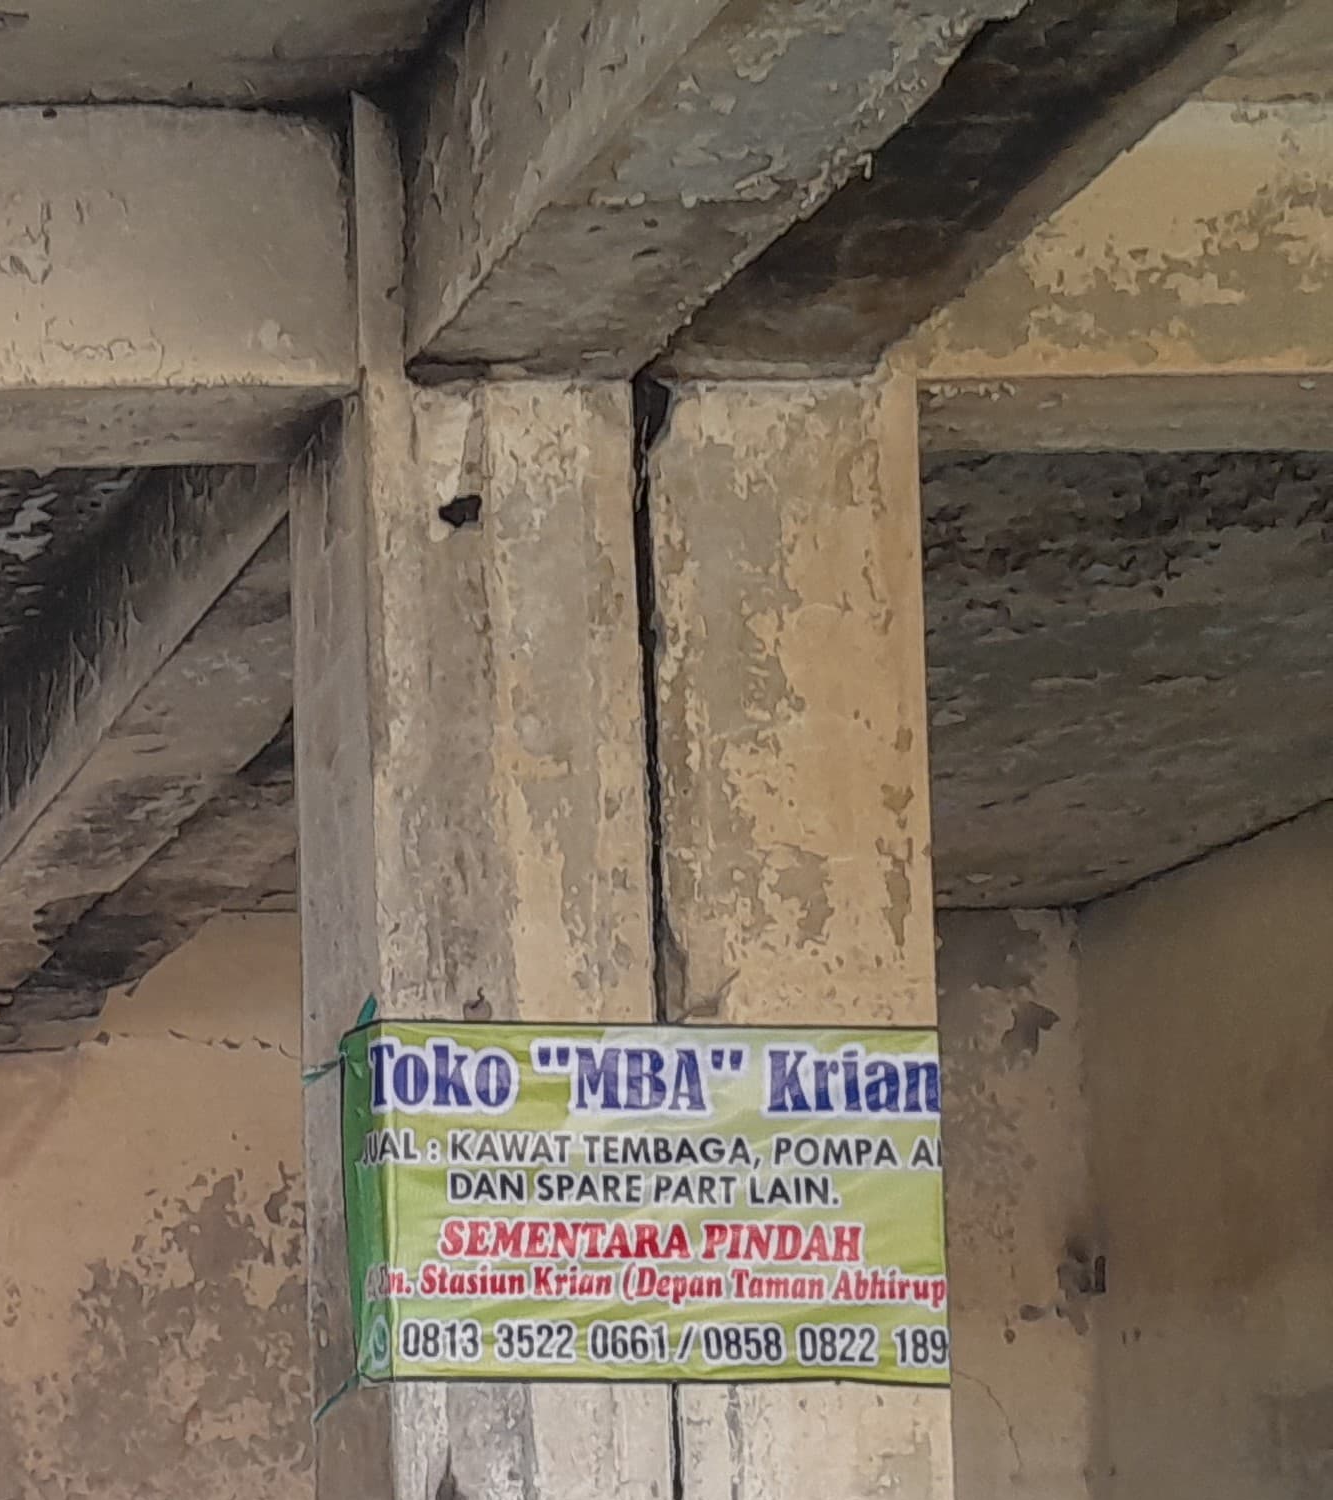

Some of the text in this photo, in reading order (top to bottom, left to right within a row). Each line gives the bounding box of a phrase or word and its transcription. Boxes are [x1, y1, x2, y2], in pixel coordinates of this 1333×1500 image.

[370, 1044, 941, 1112] Toko "MBA" Krian
[451, 1133, 571, 1164] KAWAT
[583, 1135, 761, 1169] TEMBAGA,
[774, 1137, 898, 1167] POMPA
[450, 1172, 839, 1204] DAN SPARE PART LAIN.
[440, 1220, 862, 1261] SEMENTARA PINDAH
[421, 1263, 524, 1295] Stasiun
[533, 1265, 613, 1296] Krian
[623, 1263, 722, 1304] (Depan
[731, 1269, 824, 1299] Taman
[832, 1269, 946, 1308] Abhirup
[402, 1322, 480, 1358] 0813
[496, 1323, 574, 1359] 3522
[591, 1324, 666, 1360] 0661
[703, 1326, 783, 1361] 0858
[799, 1327, 876, 1362] 0822
[895, 1328, 947, 1364] 189
